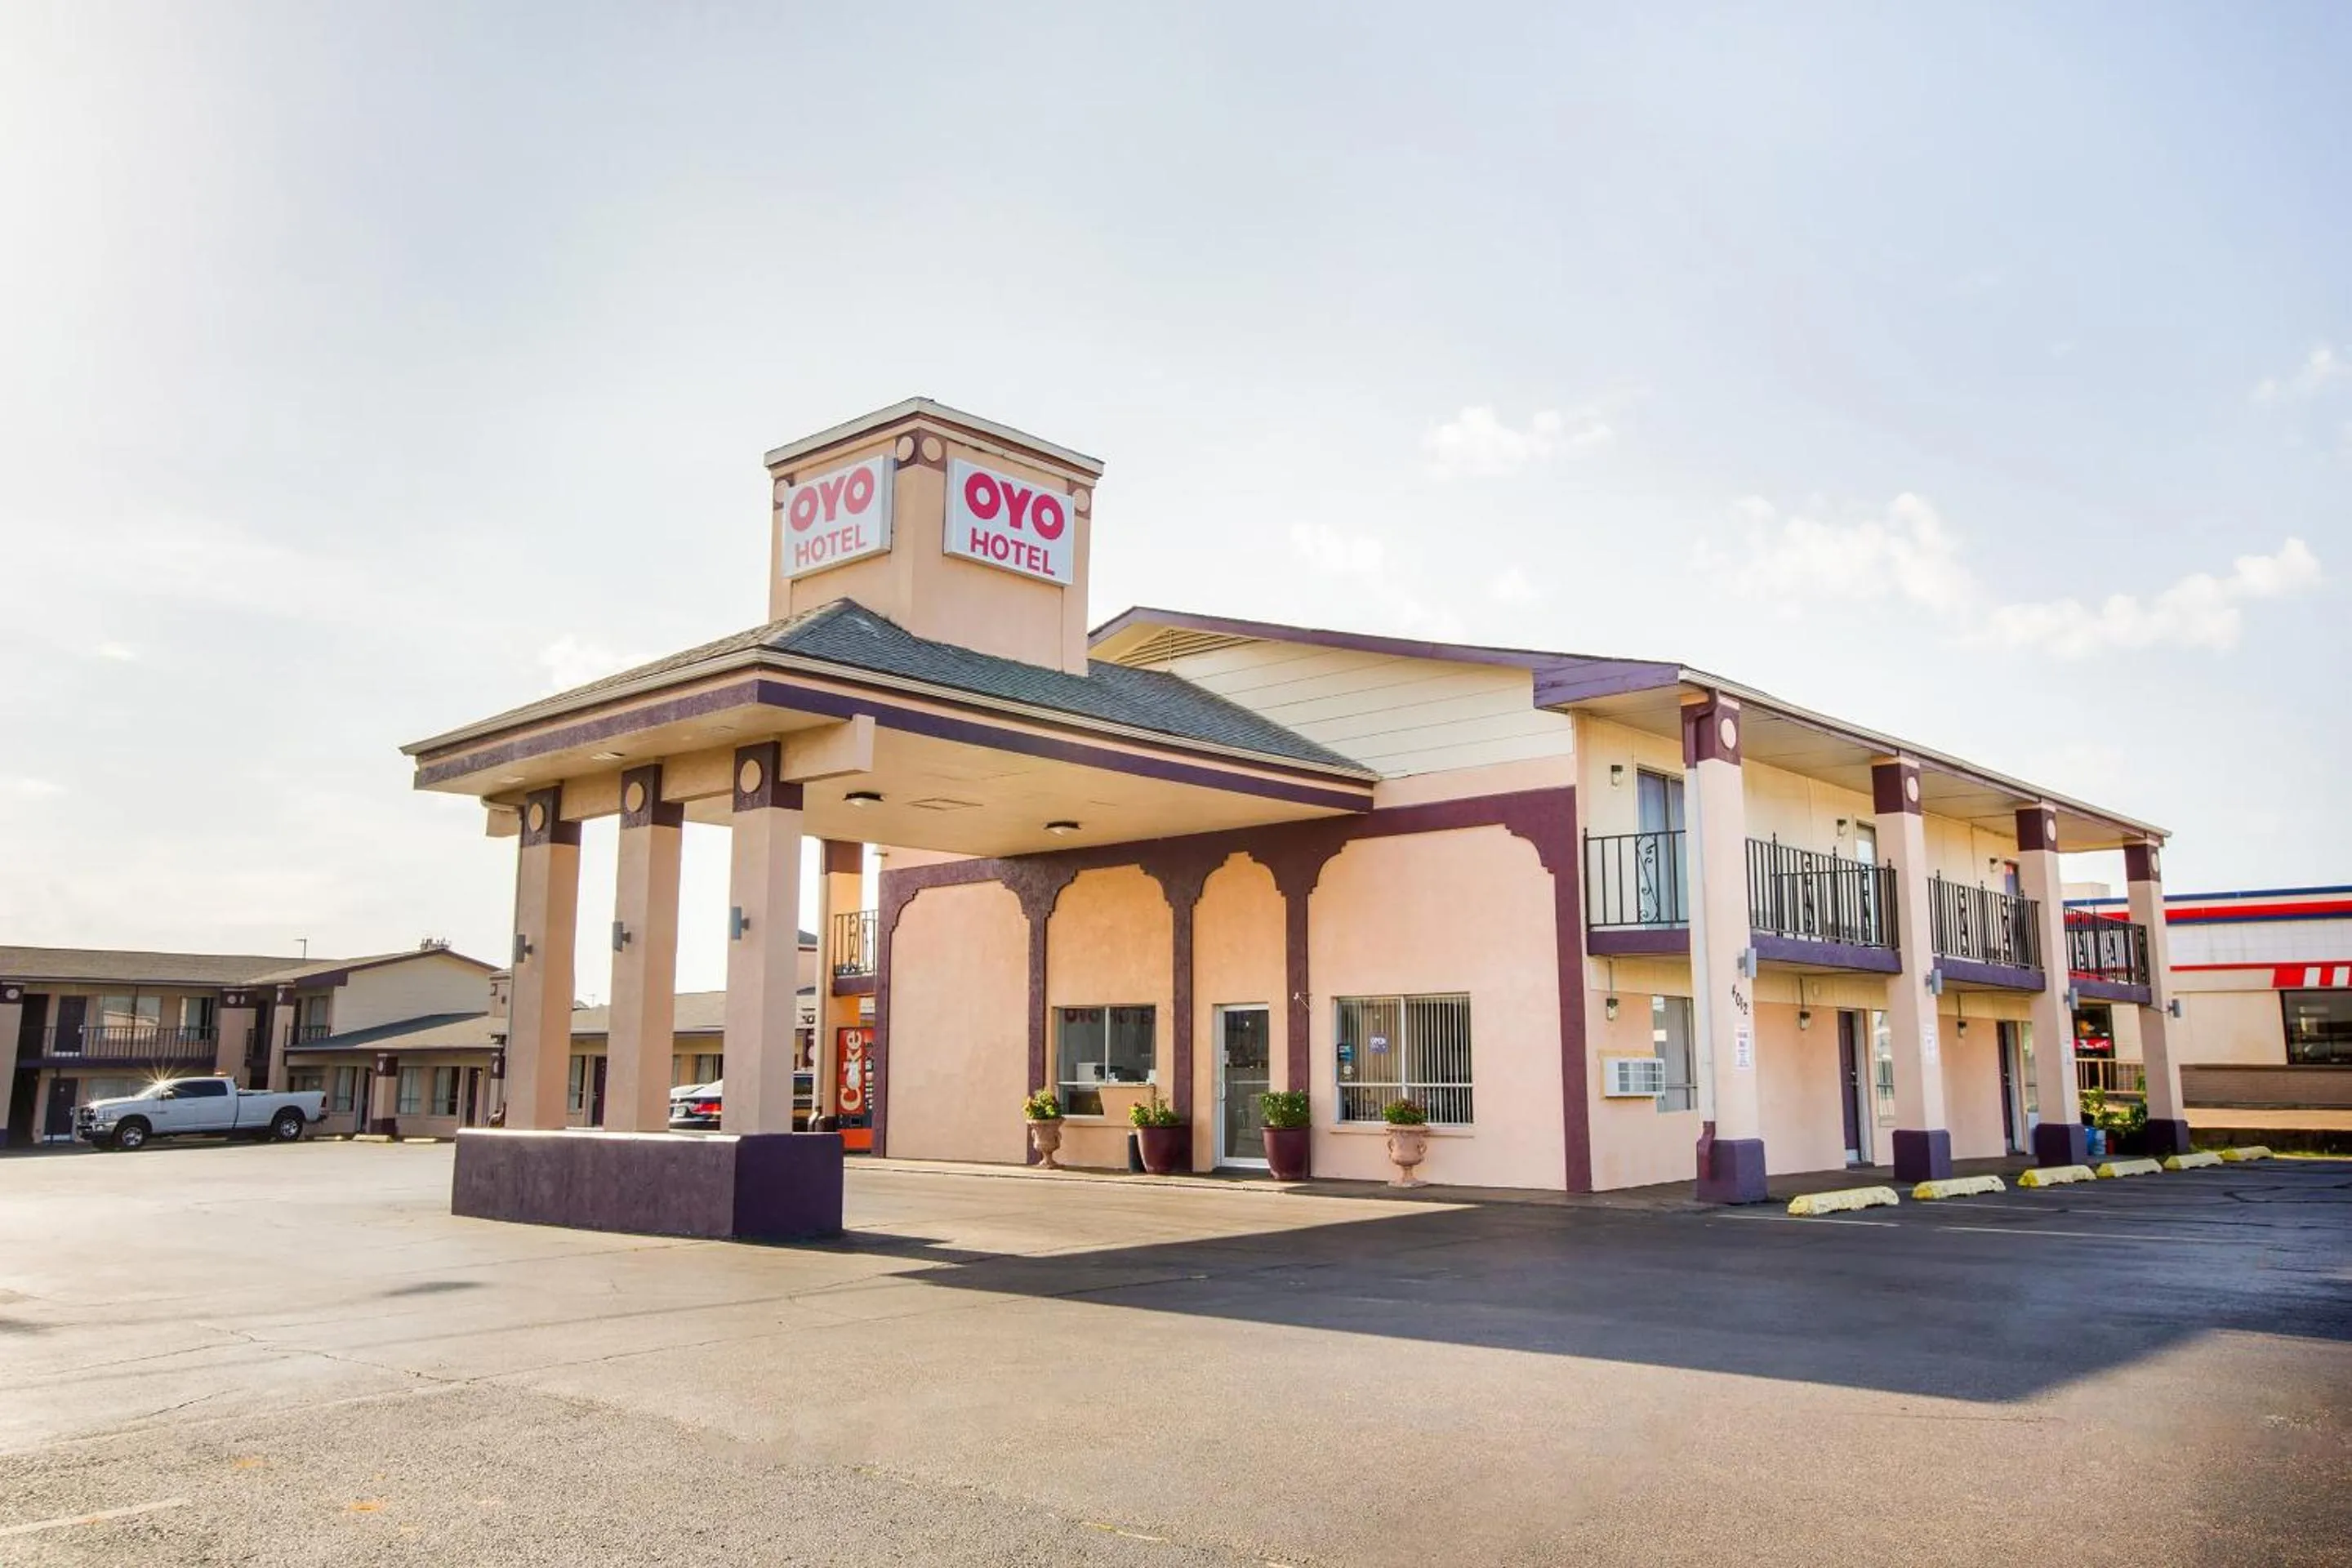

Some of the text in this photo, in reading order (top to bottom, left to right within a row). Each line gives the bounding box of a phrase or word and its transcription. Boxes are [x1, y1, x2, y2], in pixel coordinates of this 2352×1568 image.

[790, 466, 875, 532] OYO
[964, 471, 1065, 541] OYO
[795, 524, 867, 568] HOTEL
[970, 527, 1055, 575] HOTEL
